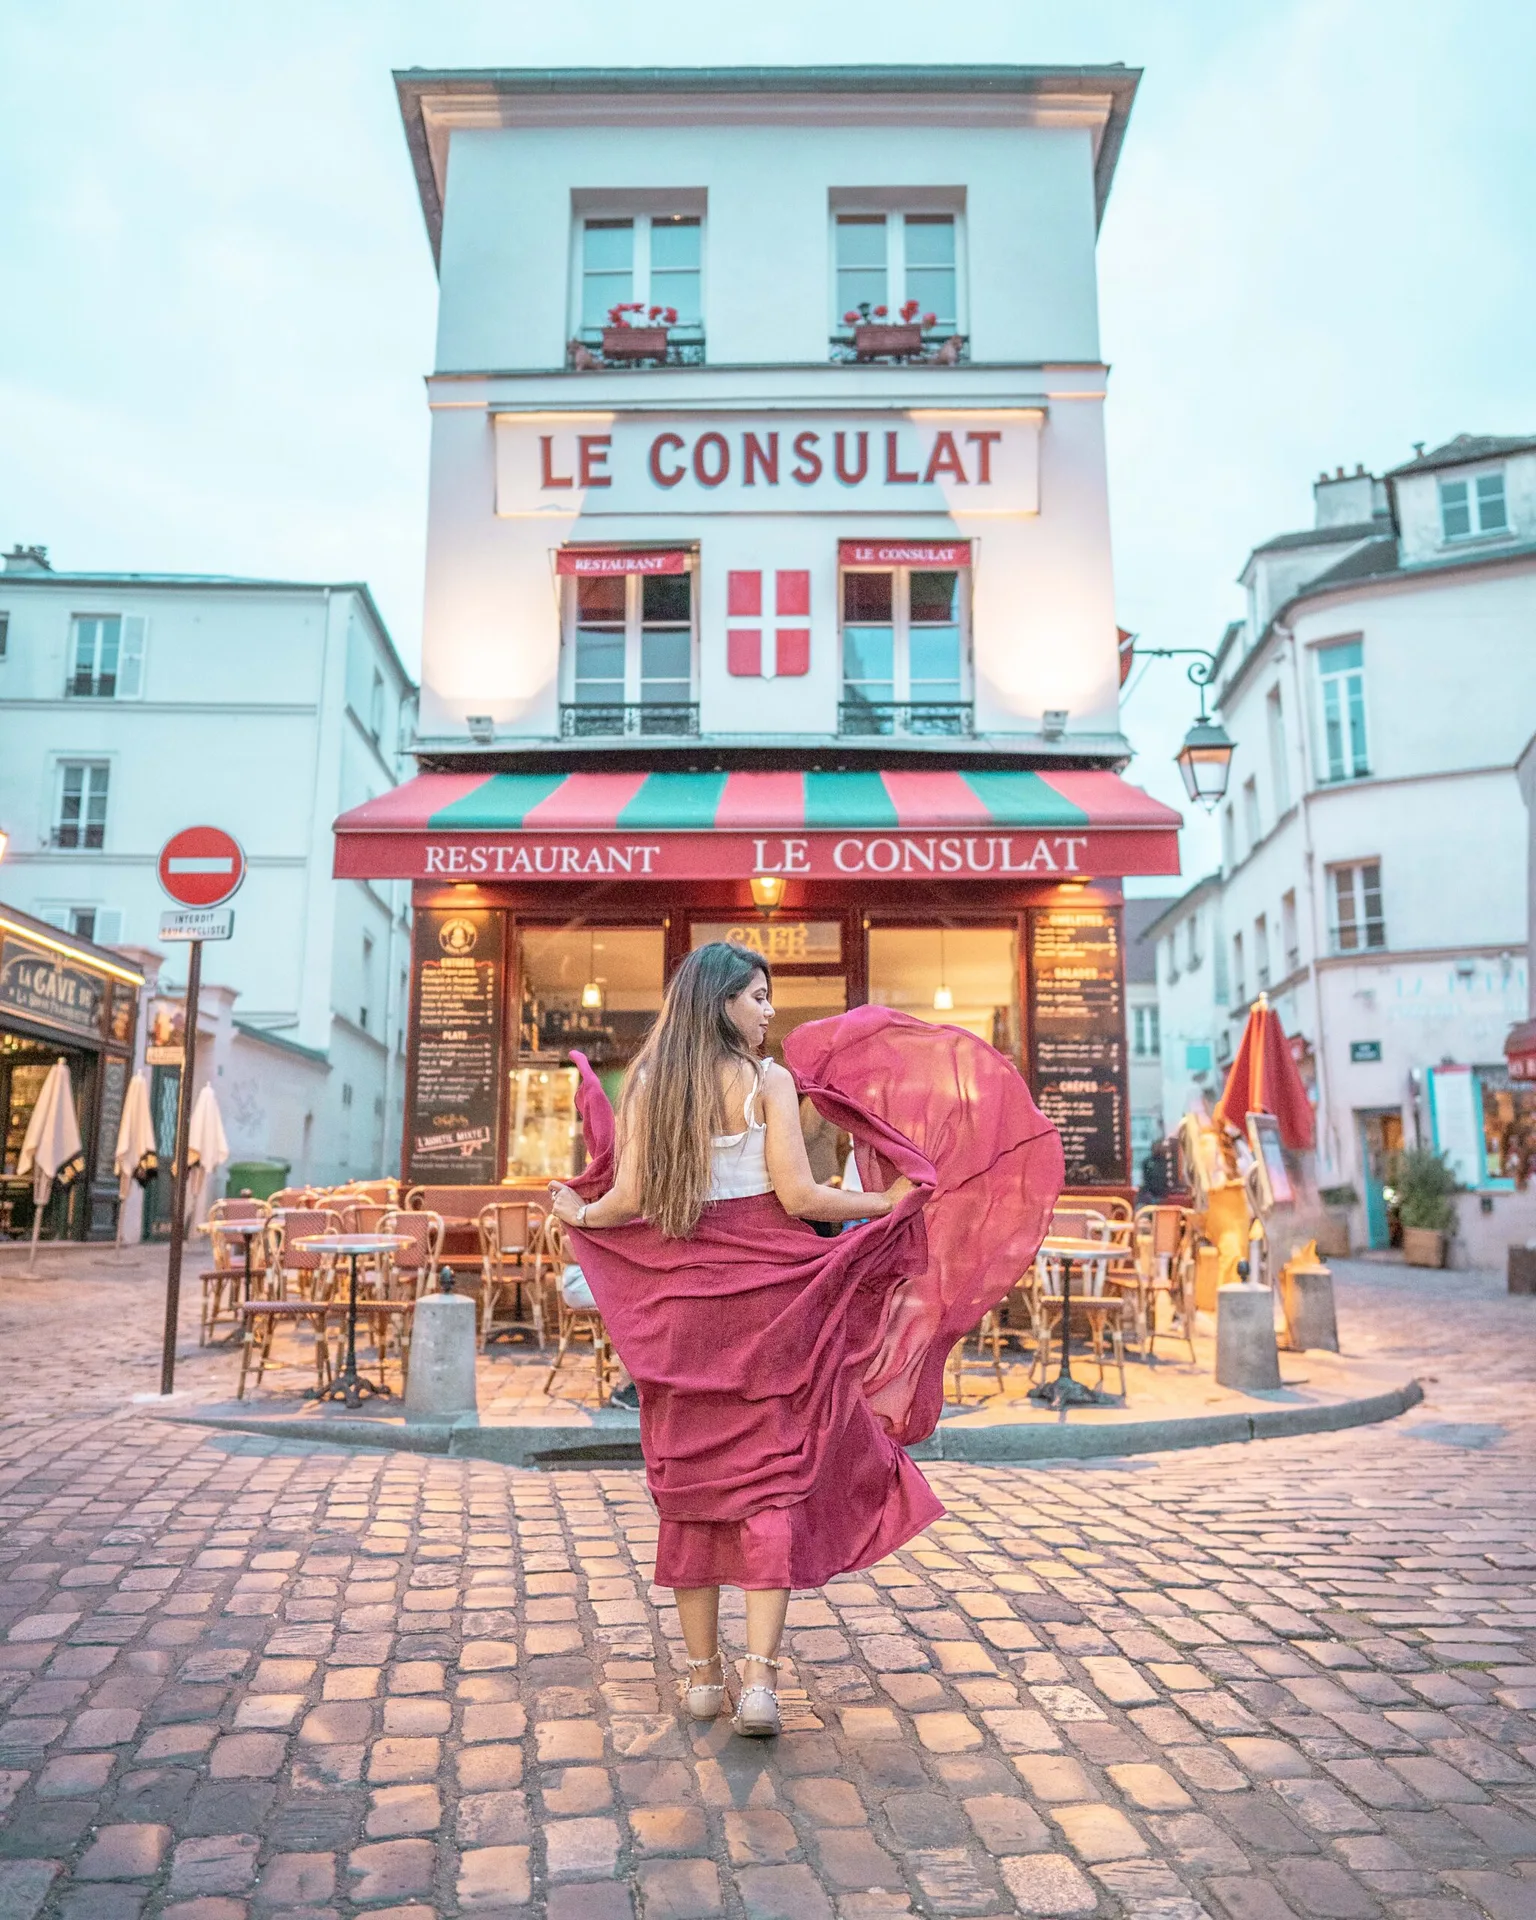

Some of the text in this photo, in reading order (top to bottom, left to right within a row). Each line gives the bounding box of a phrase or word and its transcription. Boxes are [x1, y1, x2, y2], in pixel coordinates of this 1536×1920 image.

[540, 430, 1002, 488] LE CONSULAT
[575, 557, 665, 571] RESTAURANT
[855, 548, 955, 561] LE CONSULAT
[424, 846, 660, 873] RESTAURANT
[752, 838, 1087, 873] LE CONSULAT
[174, 913, 214, 925] INTERDIT
[33, 966, 77, 1006] CAVE
